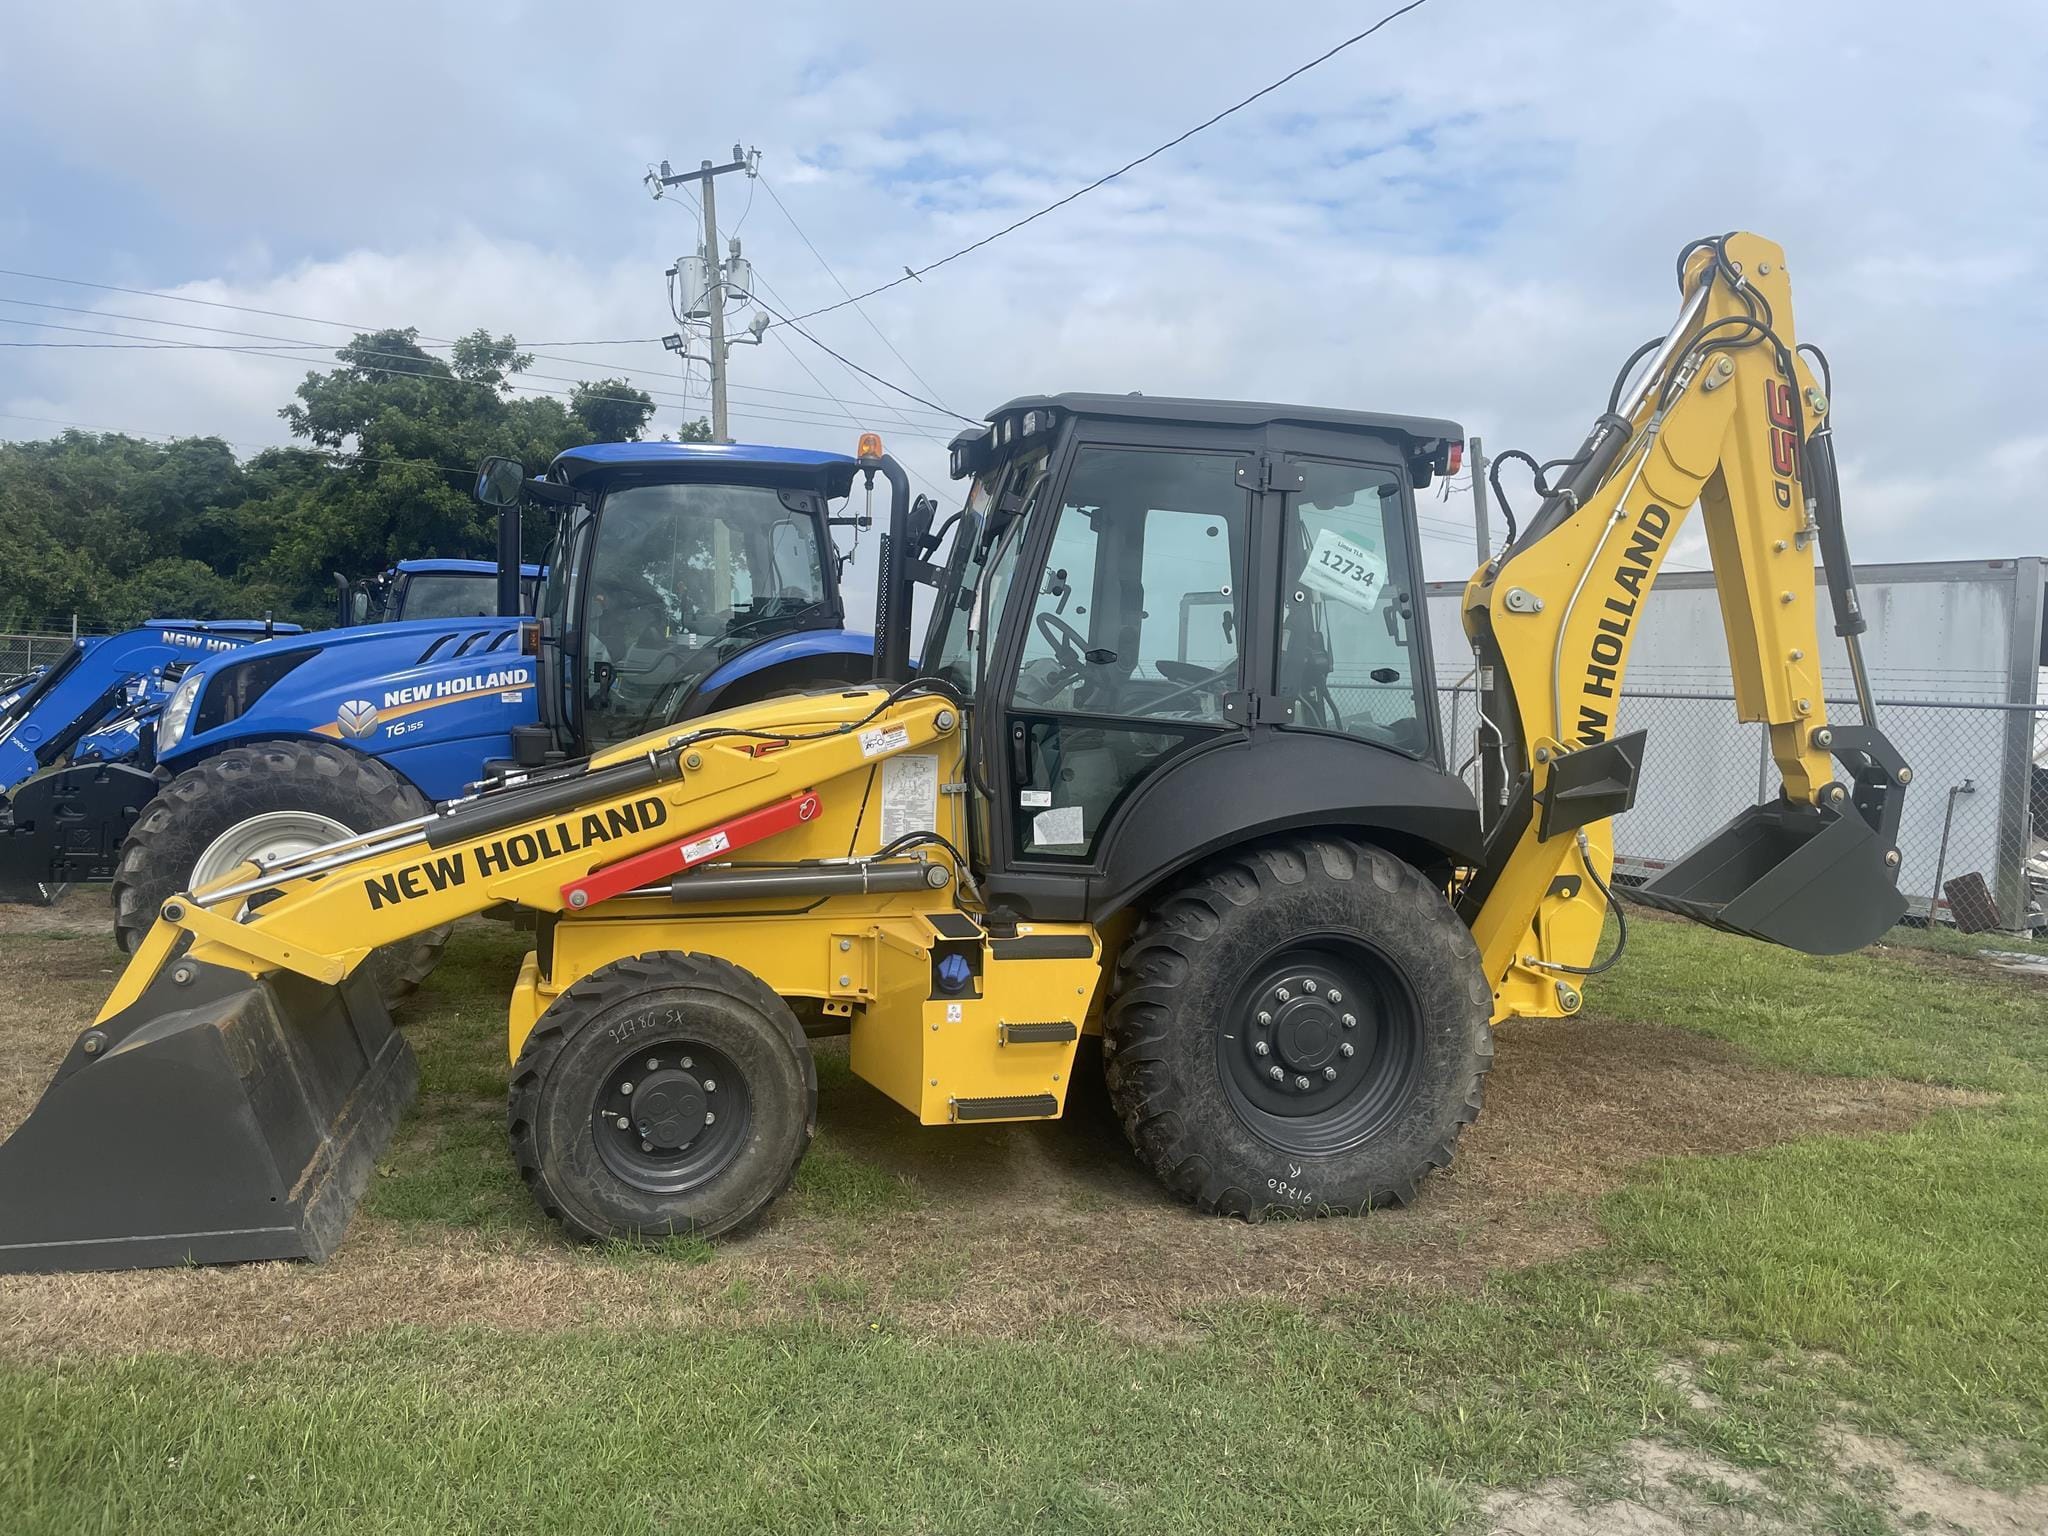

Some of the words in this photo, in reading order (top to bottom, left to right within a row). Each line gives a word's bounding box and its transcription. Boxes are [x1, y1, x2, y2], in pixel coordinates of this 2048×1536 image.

[1319, 549, 1376, 588] 12734
[1583, 503, 1670, 698] HOLLAND
[162, 631, 203, 649] NEW
[384, 683, 433, 708] NEW
[437, 669, 529, 697] HOLLAND
[363, 852, 466, 911] NEW
[474, 796, 668, 878] HOLLAND
